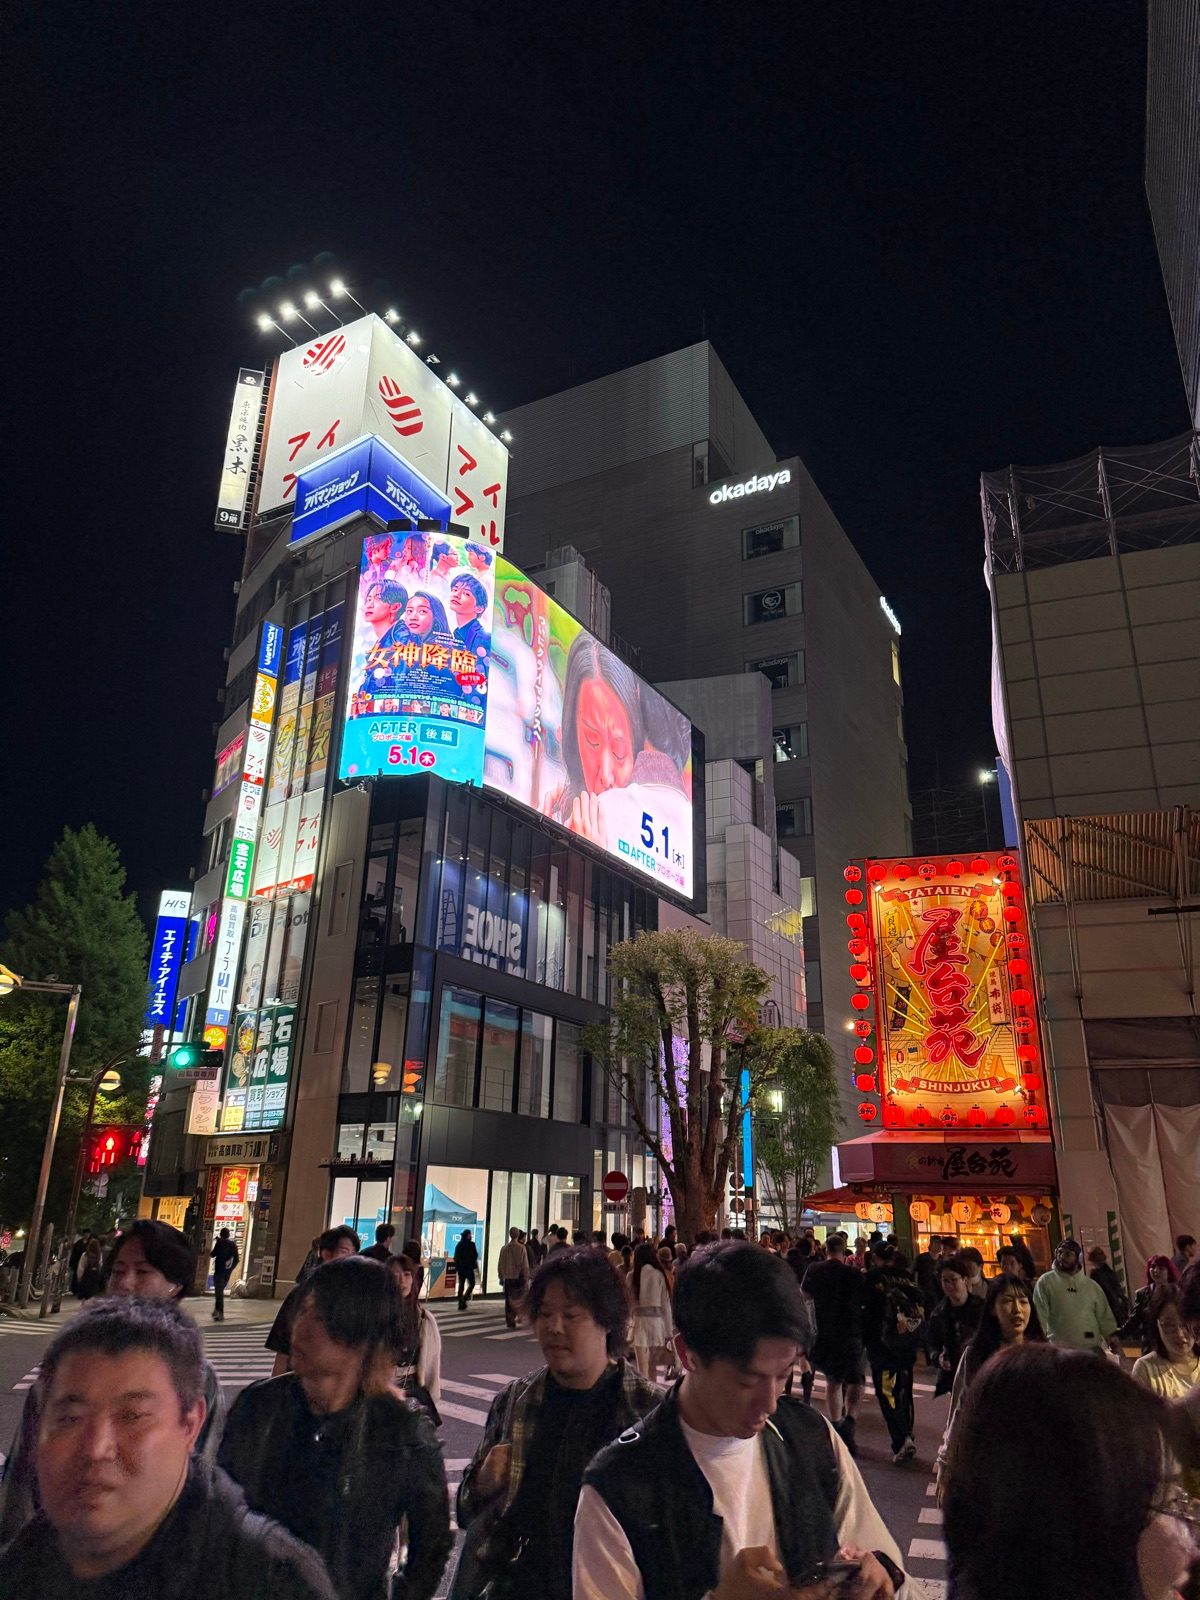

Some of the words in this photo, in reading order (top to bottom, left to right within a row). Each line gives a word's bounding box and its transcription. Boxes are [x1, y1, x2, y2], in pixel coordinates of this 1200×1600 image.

[287, 419, 341, 461] アイ
[303, 471, 360, 510] アパマンショップ
[709, 469, 791, 504] okadaya
[219, 511, 238, 524] 9階
[365, 642, 477, 673] 女神降臨
[369, 722, 418, 734] AFTER
[425, 728, 453, 742] 後編
[248, 753, 264, 765] アイ
[388, 745, 418, 765] 5.1
[640, 811, 669, 859] 5.1
[229, 843, 250, 897] 宝石広場
[630, 846, 656, 871] AFTER
[905, 885, 972, 900] YATAIEN
[151, 929, 177, 1016] エイチ・アイ・エス
[906, 906, 990, 1069] 屋台苑
[989, 988, 1004, 1015] 布袋
[214, 1011, 224, 1023] 1F
[257, 1014, 294, 1046] 宝石
[253, 1046, 289, 1079] 広場
[918, 1079, 992, 1094] SHINJUKU
[218, 1144, 243, 1157] 高価買取
[942, 1146, 1018, 1180] 屋台苑
